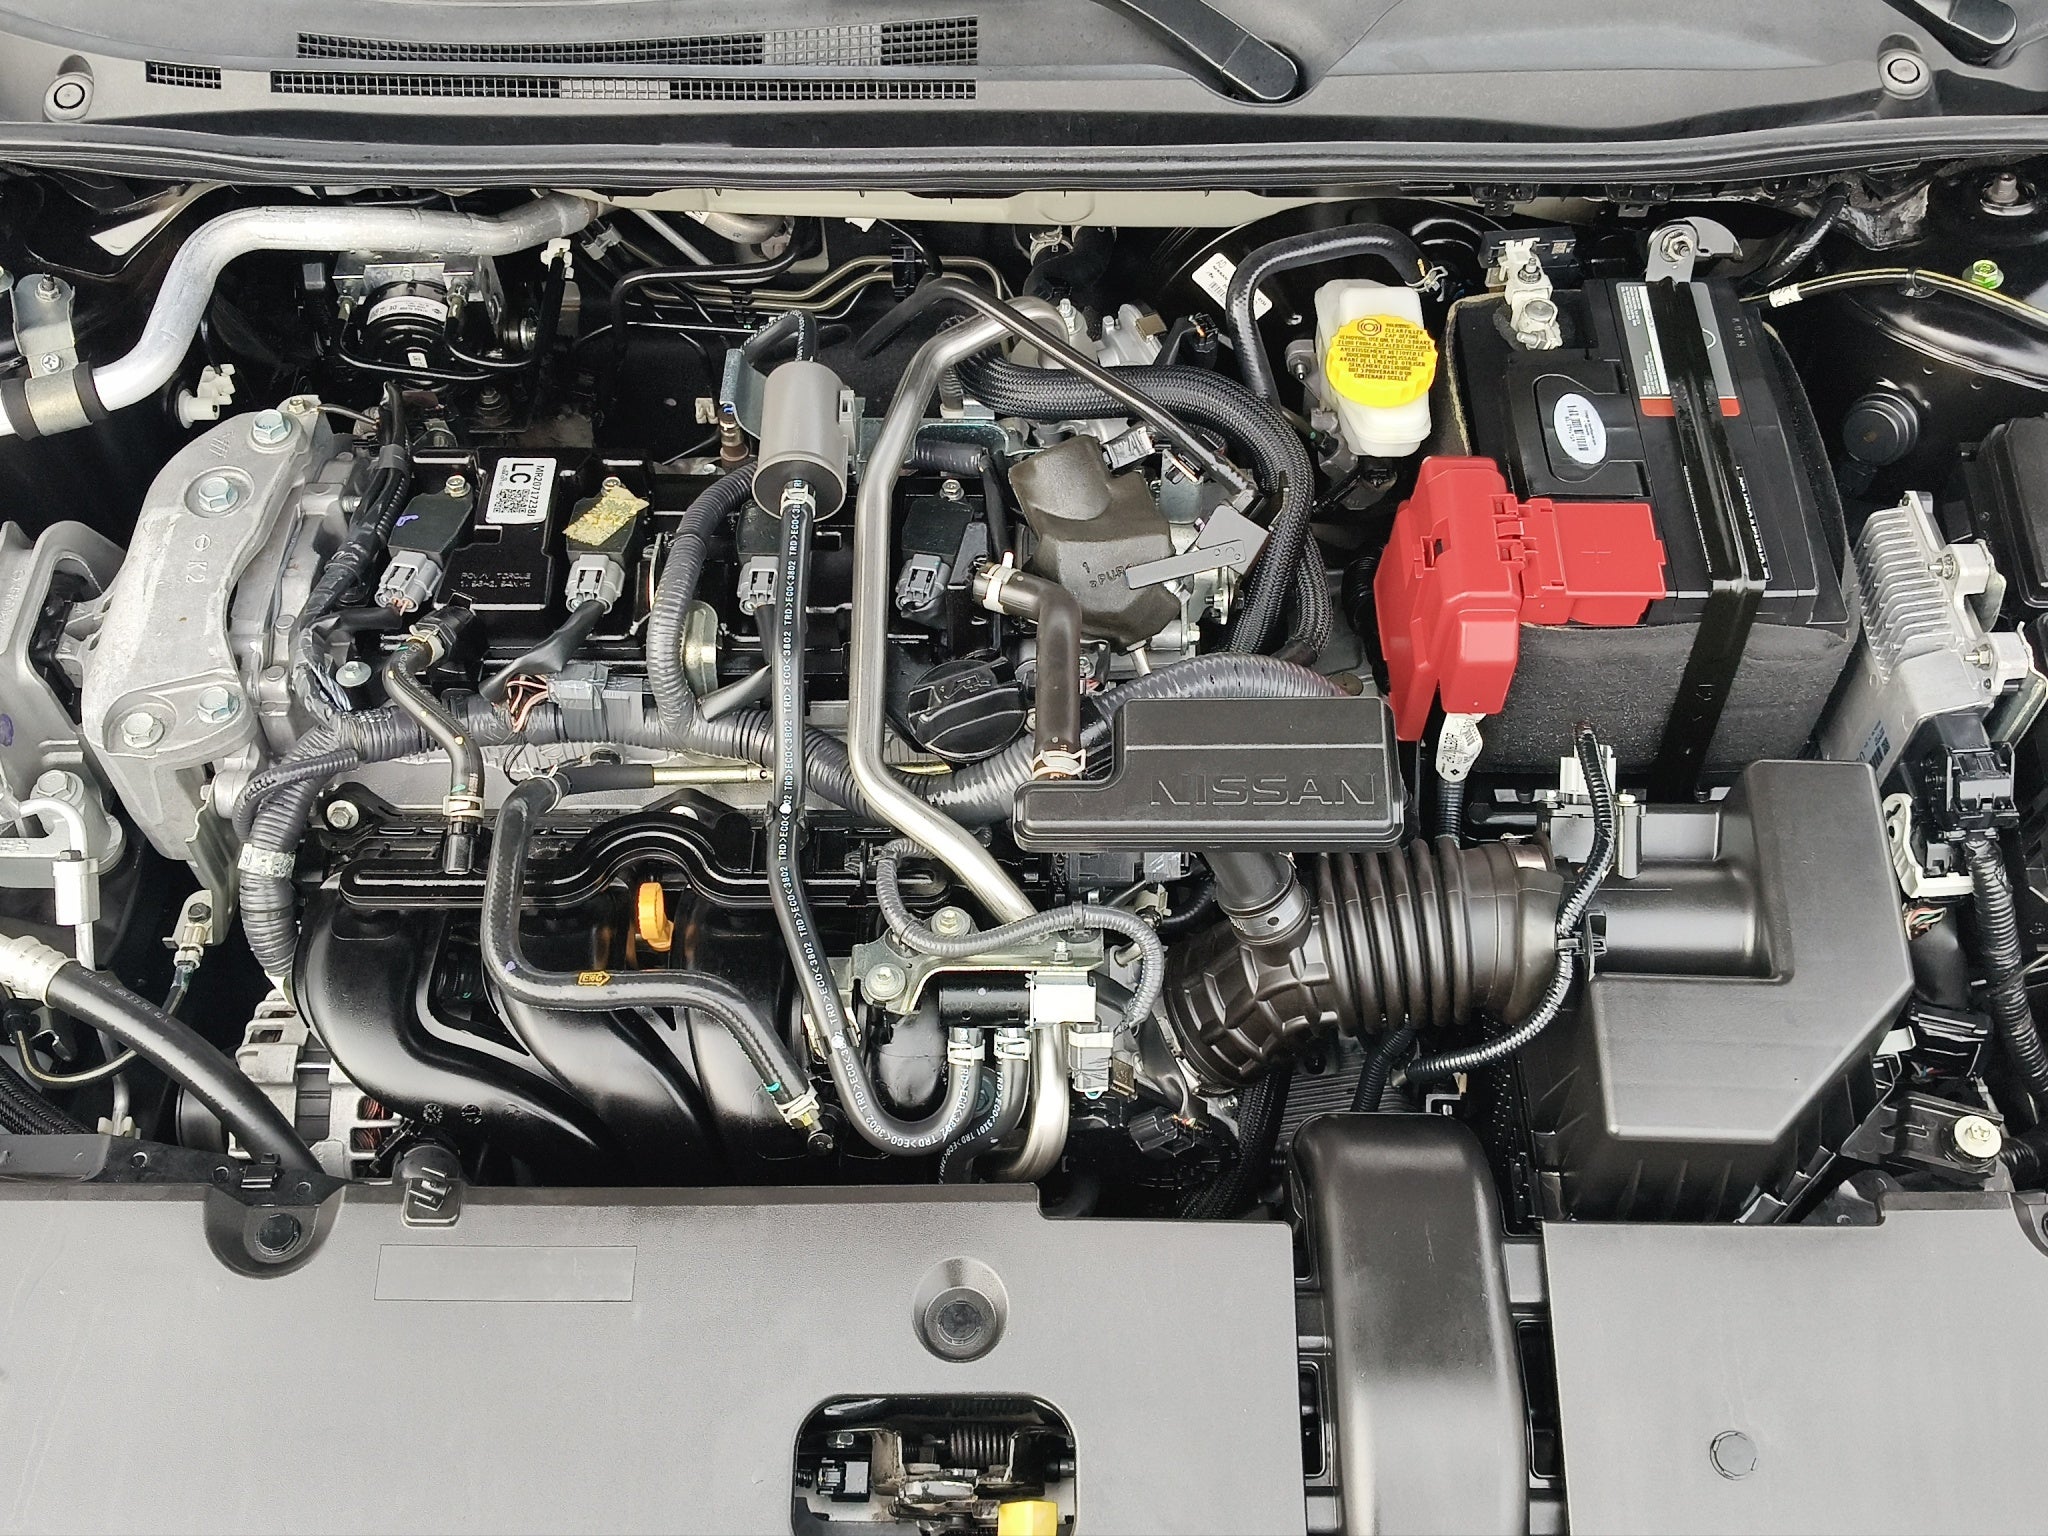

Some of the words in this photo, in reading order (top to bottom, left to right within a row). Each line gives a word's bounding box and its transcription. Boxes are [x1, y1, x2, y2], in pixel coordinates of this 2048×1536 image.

[510, 463, 534, 484] LC
[186, 560, 208, 583] K2
[783, 560, 797, 626] TRD>ECO<3802
[782, 631, 792, 713] TRD>ECO<3802
[784, 719, 794, 791] TRD>ECO<3802
[1150, 773, 1375, 807] NISSAN
[779, 866, 808, 937] TRD>ECO<3802
[803, 942, 838, 1025] TRD>ECO<3802
[864, 1115, 939, 1148] TRD>ECO<3802
